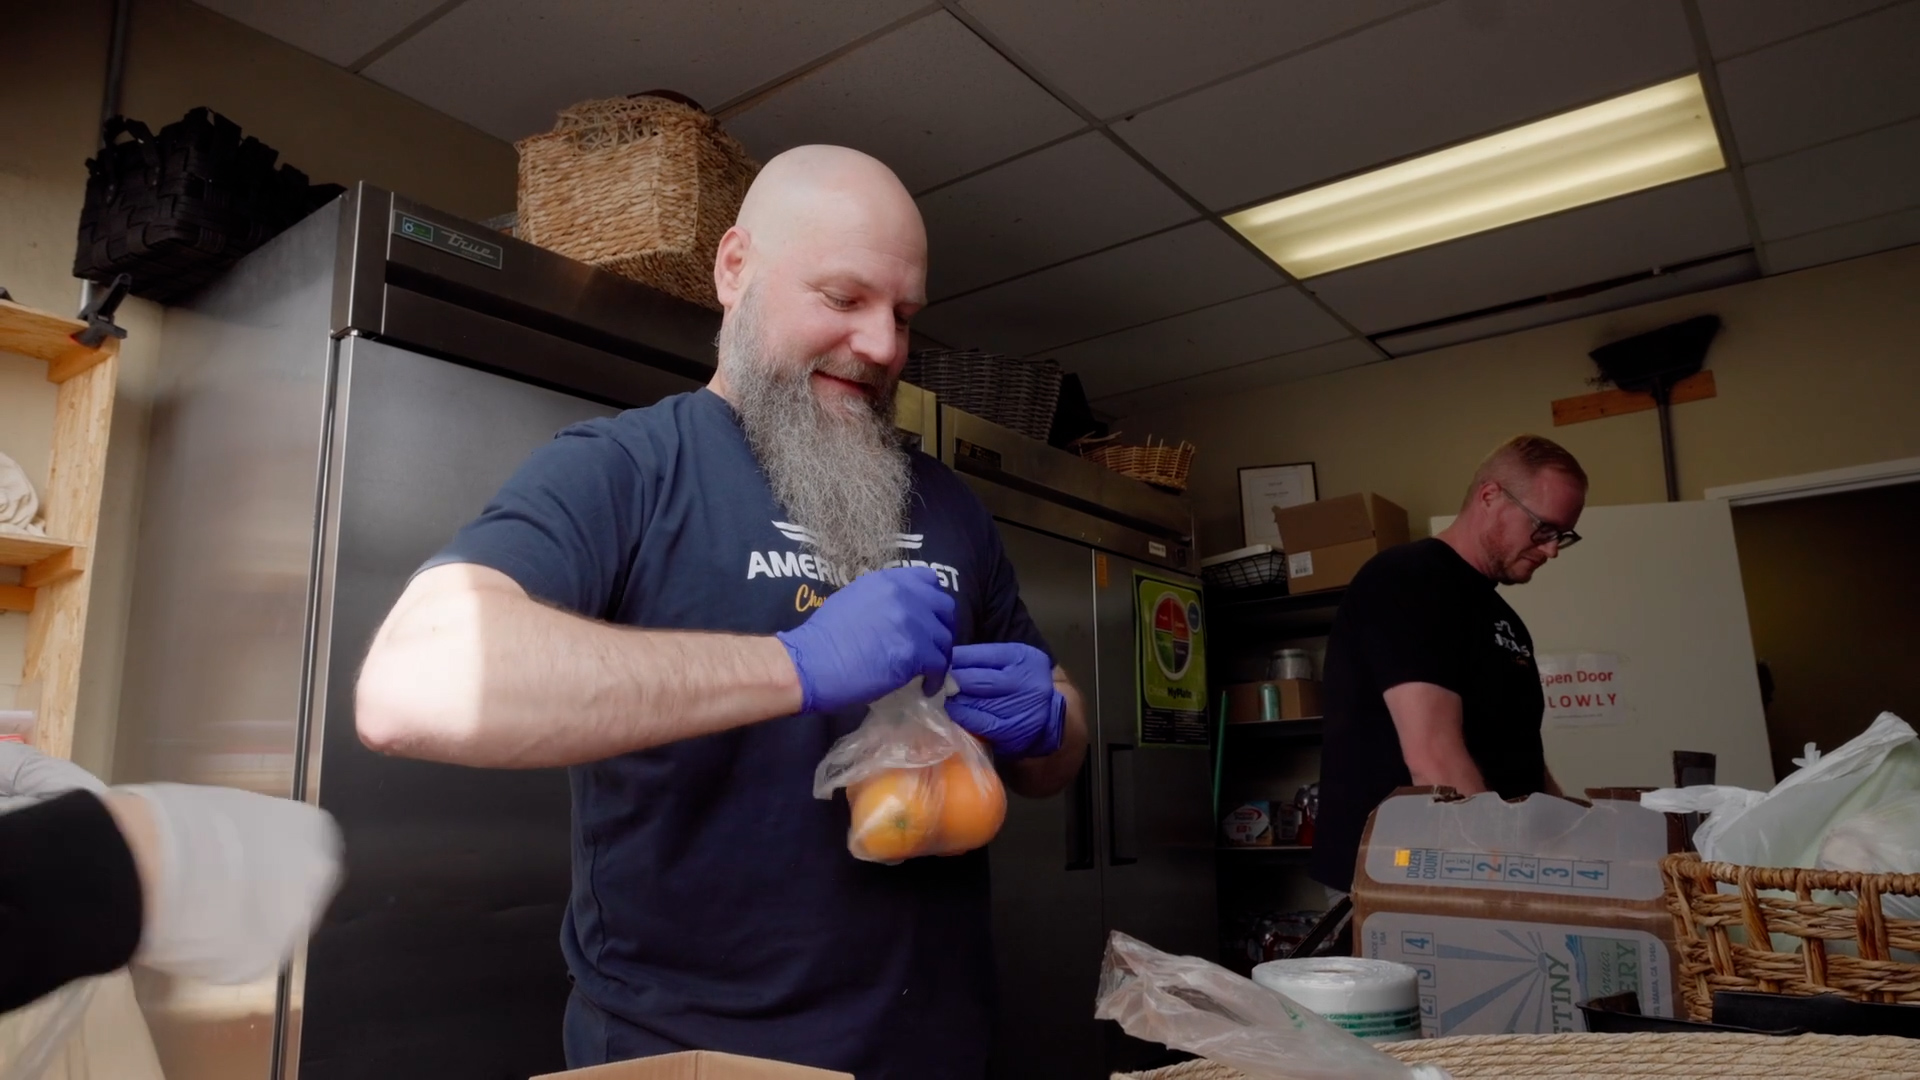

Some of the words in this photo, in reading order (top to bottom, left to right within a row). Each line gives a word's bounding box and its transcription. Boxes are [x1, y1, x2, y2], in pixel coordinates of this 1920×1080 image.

[747, 550, 853, 587] AMERIC
[1540, 674, 1572, 686] pen
[1576, 670, 1613, 683] Door
[1548, 693, 1617, 709] LOWLY
[1405, 850, 1421, 879] DOZEN
[1422, 849, 1438, 879] COUNT
[1475, 861, 1502, 873] 2
[1542, 867, 1570, 878] 3
[1576, 870, 1604, 881] 4
[1404, 938, 1430, 950] 4
[1599, 951, 1612, 996] ornia
[1617, 943, 1638, 992] ERY
[1545, 952, 1574, 1033] STINY
